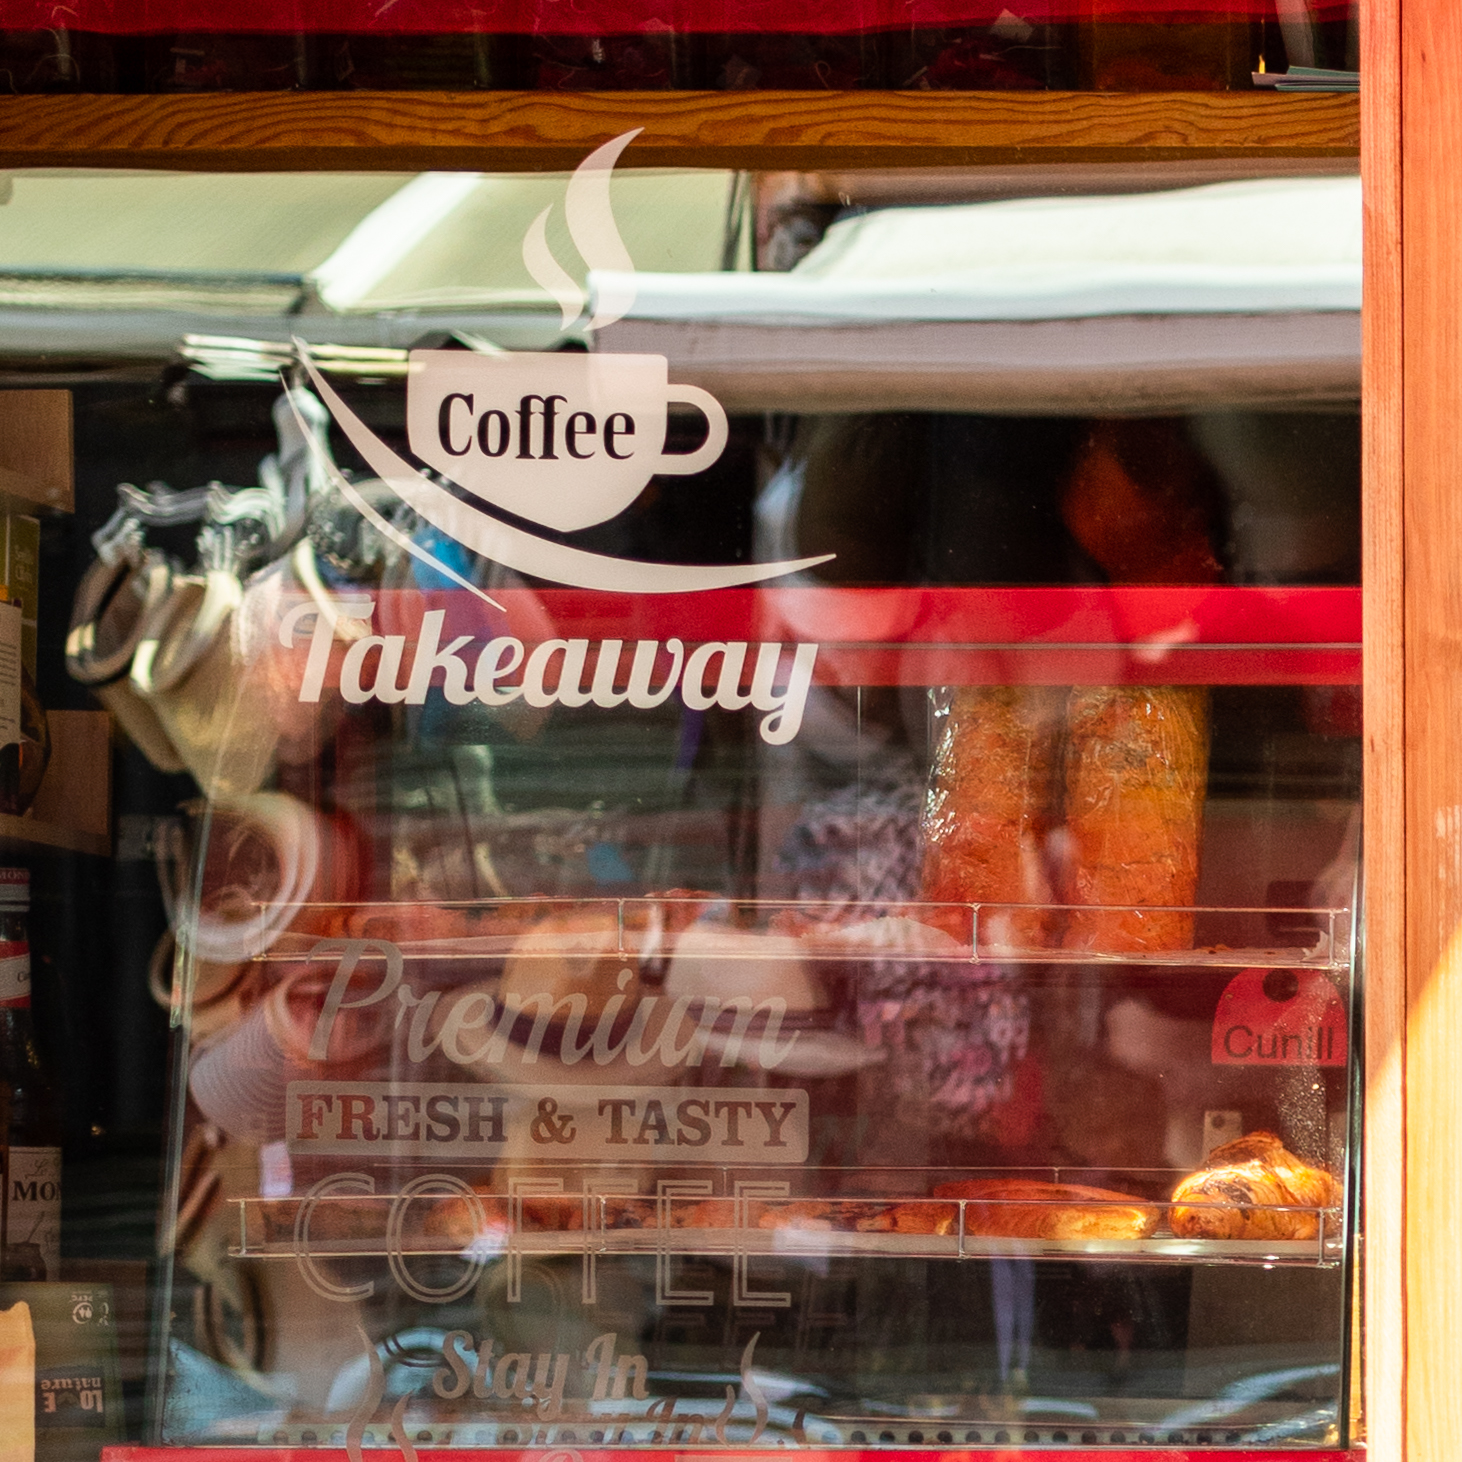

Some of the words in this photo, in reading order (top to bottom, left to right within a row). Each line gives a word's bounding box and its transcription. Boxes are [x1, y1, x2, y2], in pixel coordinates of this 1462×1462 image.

[437, 392, 637, 462] Coffee
[278, 594, 819, 748] Takeaway
[302, 939, 800, 1071] Premium
[1223, 1024, 1334, 1060] Cunill
[299, 1094, 509, 1143] FRESH
[528, 1096, 577, 1146] &
[598, 1098, 798, 1147] TASTY
[294, 1172, 793, 1307] COFFEE
[430, 1329, 572, 1423] Stay
[584, 1332, 651, 1401] In
